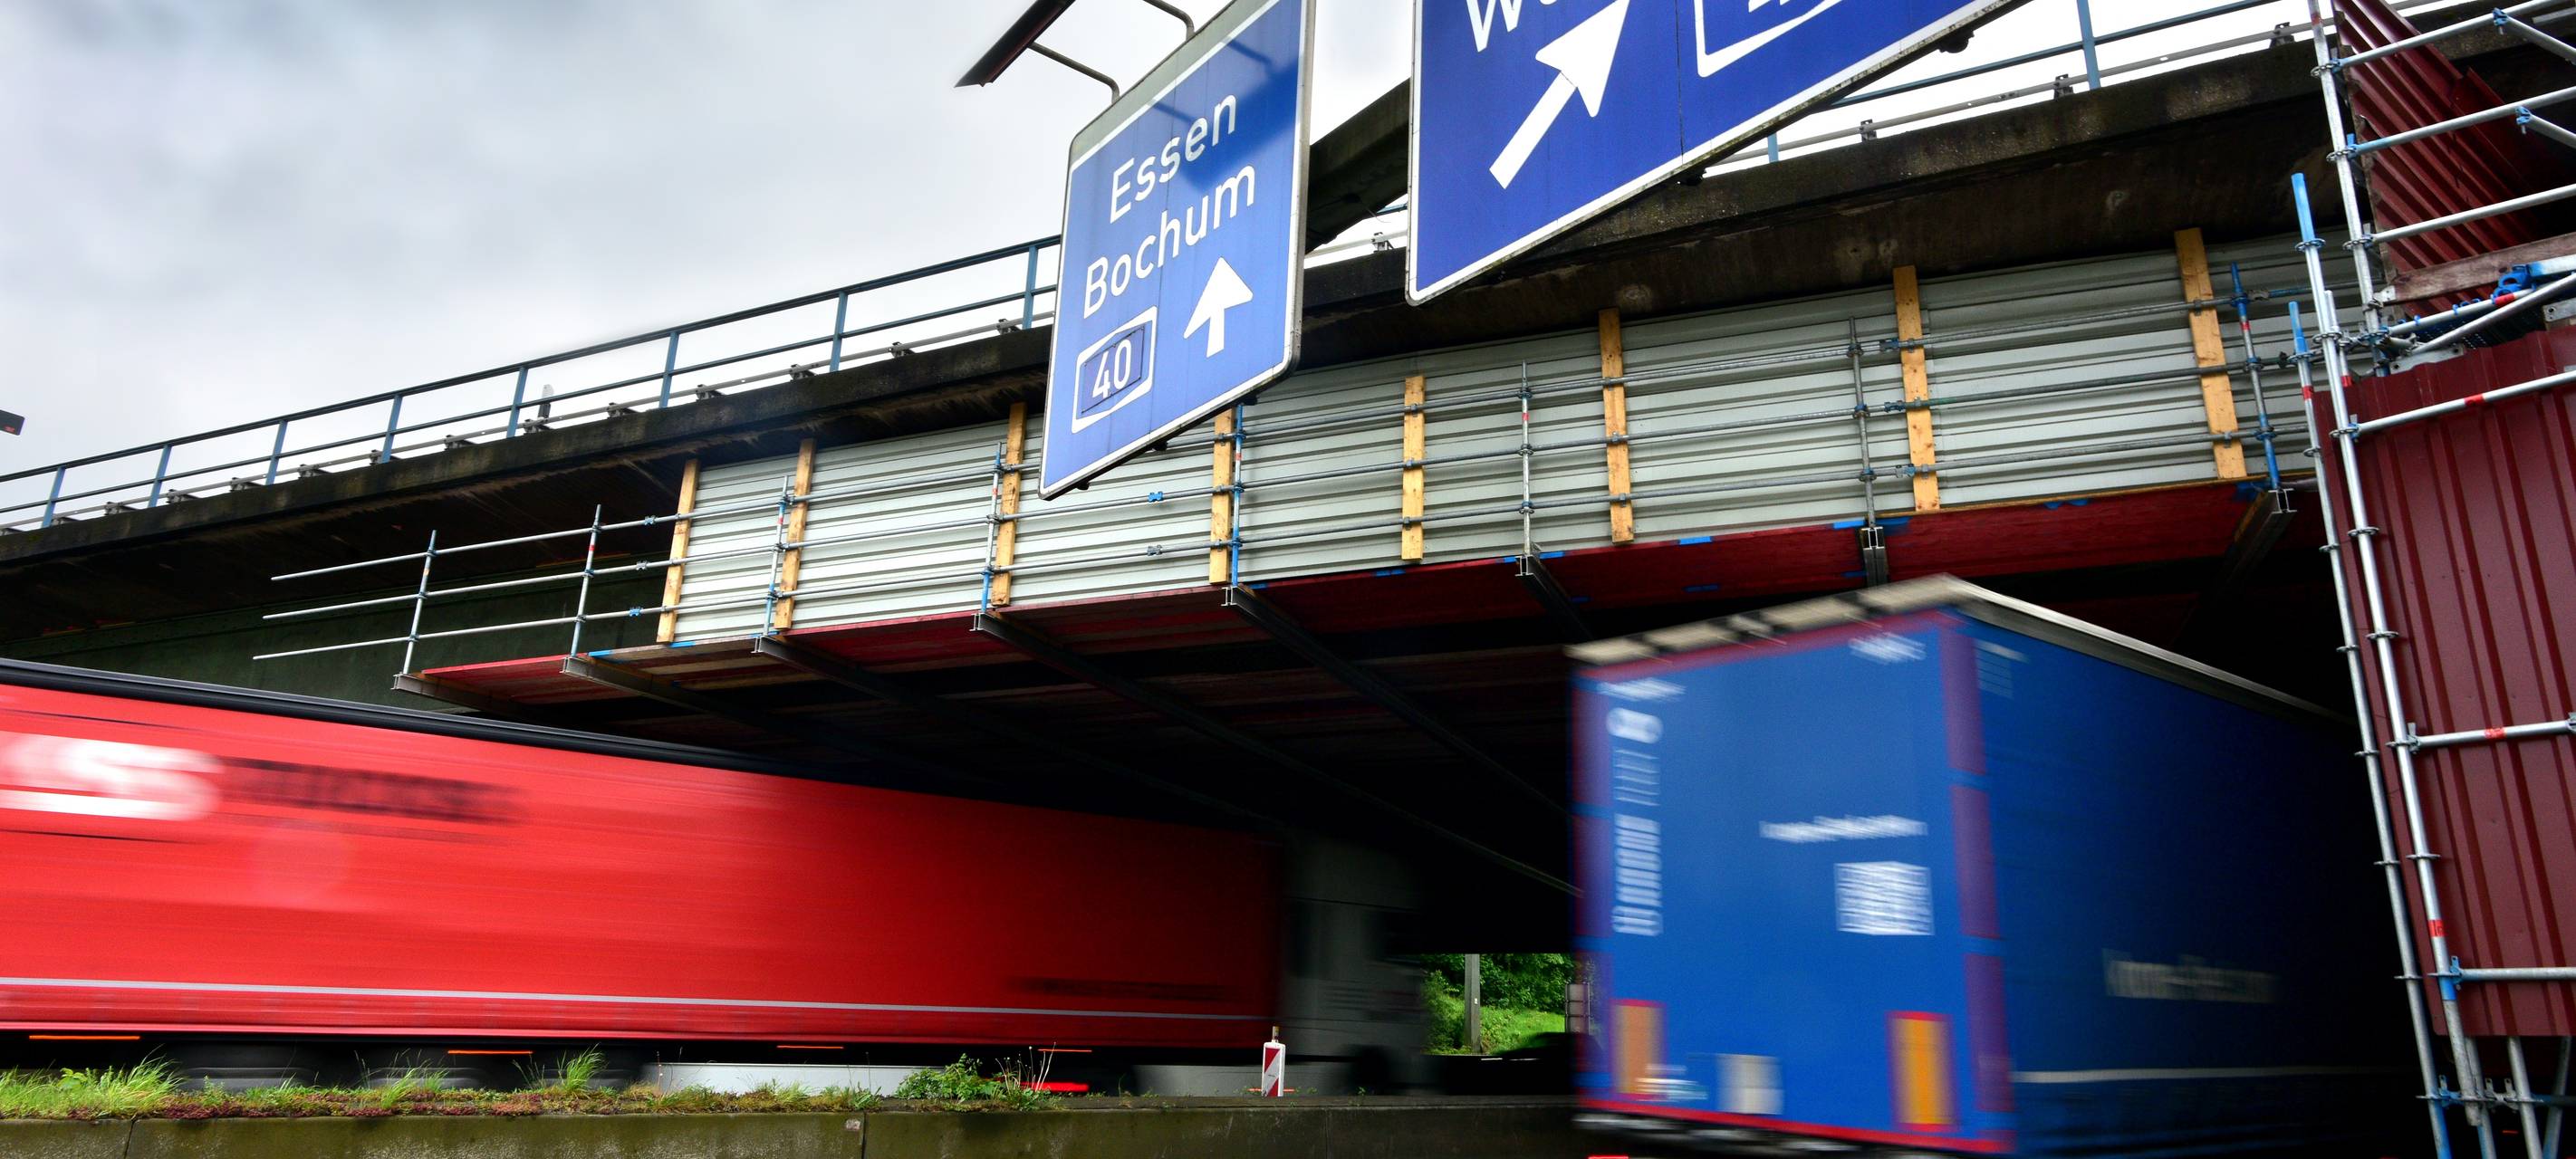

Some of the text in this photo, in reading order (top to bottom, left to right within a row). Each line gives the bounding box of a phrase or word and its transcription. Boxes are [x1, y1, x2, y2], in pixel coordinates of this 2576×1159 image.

[1110, 95, 1236, 224] Essen
[1084, 166, 1255, 319] Bochum
[1092, 340, 1131, 398] 40
